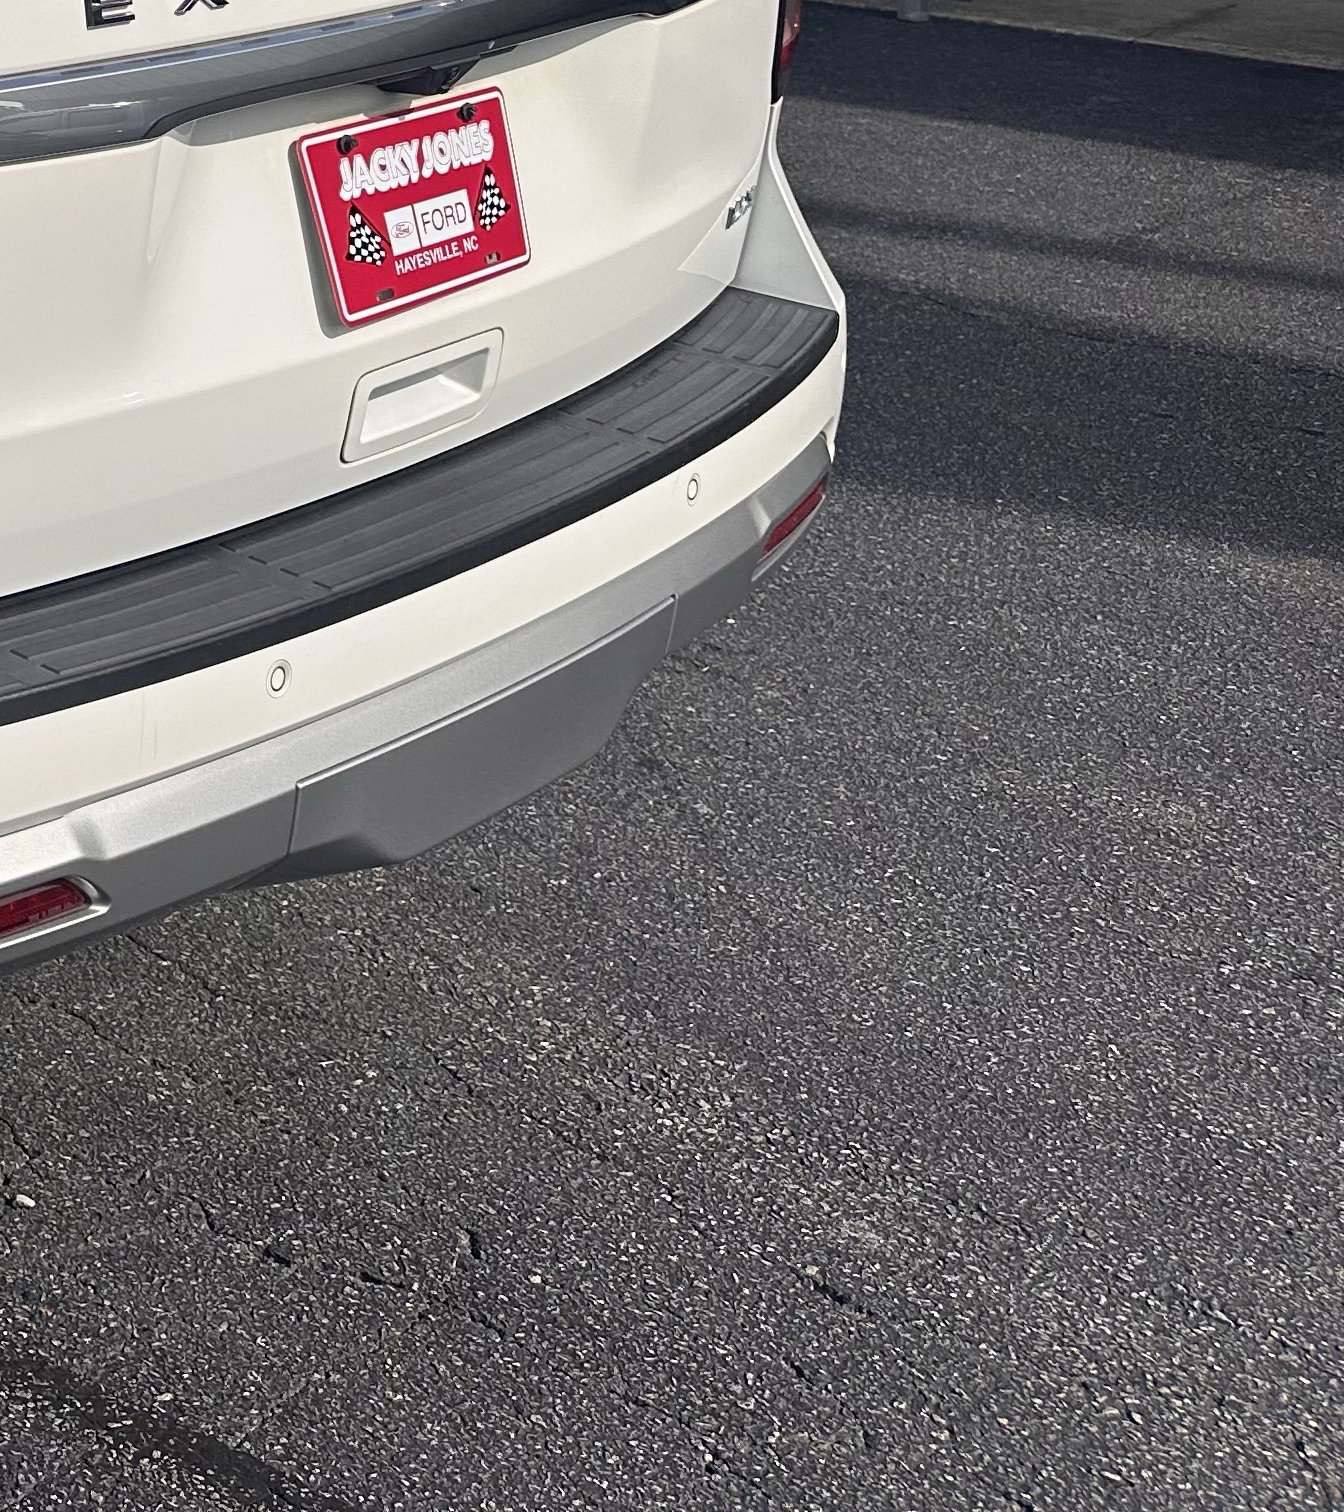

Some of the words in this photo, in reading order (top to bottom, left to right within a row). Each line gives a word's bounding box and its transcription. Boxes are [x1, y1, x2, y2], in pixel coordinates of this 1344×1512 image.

[339, 138, 419, 201] JACKY
[421, 119, 495, 179] JONES
[420, 201, 467, 235] FORD
[394, 241, 464, 276] HAYESVILLE,
[462, 235, 480, 254] NC
